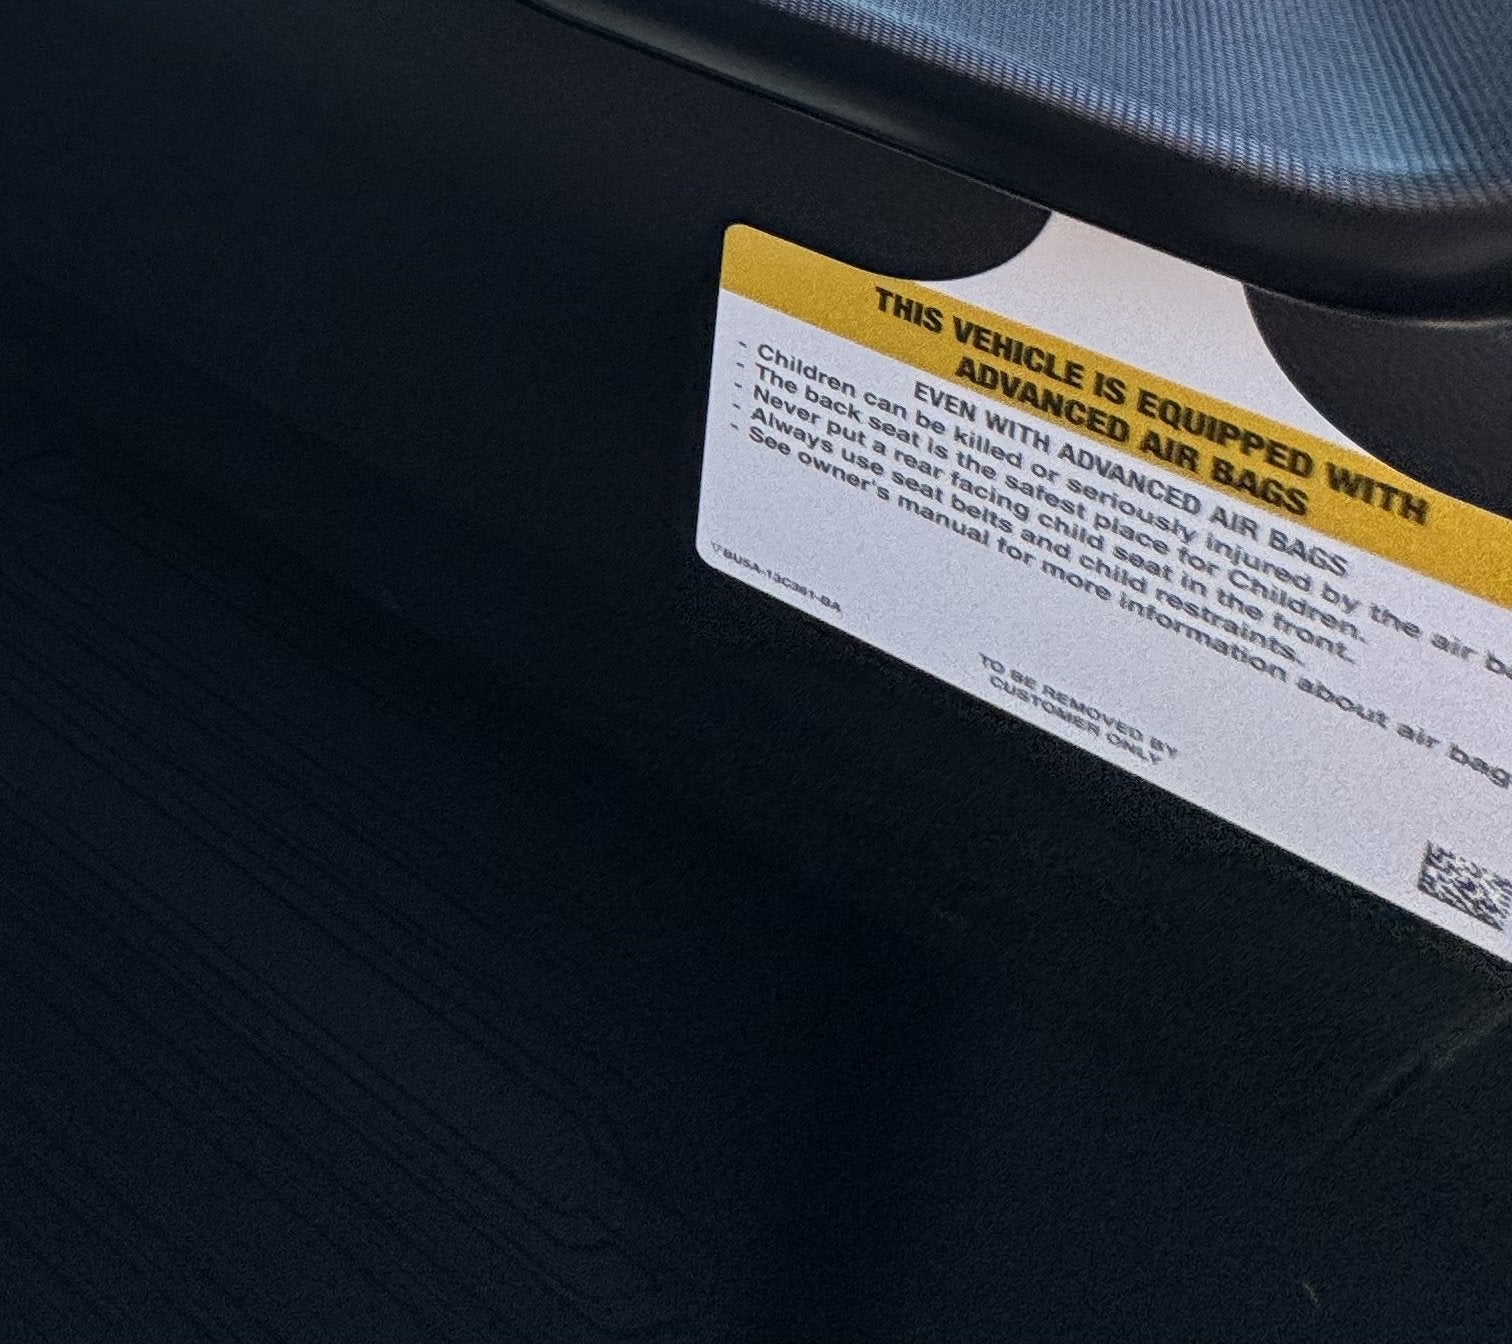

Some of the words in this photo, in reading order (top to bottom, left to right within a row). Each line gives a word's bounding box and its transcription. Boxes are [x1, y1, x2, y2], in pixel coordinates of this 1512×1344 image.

[753, 383, 821, 426] Never
[826, 419, 867, 448] put
[871, 439, 887, 457] a
[893, 448, 945, 480] rear
[949, 470, 1031, 523] facing
[1037, 513, 1105, 552] child
[1112, 545, 1174, 583] seat
[1180, 570, 1208, 598] in
[1216, 588, 1265, 622] the
[1272, 611, 1355, 665] front.
[754, 361, 799, 395] The
[804, 384, 861, 424] back
[867, 415, 920, 449] seat
[926, 436, 949, 460] is
[955, 450, 997, 481] the
[1004, 474, 1087, 521] safest
[1092, 512, 1171, 556] place
[1177, 546, 1221, 577] for
[1227, 568, 1366, 644] Children.
[757, 343, 856, 399] Children
[862, 391, 908, 421] can
[914, 409, 947, 436] be
[953, 425, 1023, 470] killed
[1030, 462, 1060, 484] or
[1066, 478, 1197, 545] seriously
[1205, 532, 1313, 593] injured
[1320, 582, 1361, 615] by
[1370, 604, 1422, 640] the
[1430, 633, 1477, 661] air
[875, 285, 944, 335] THIS
[952, 315, 1085, 391] VEHICLE
[1093, 371, 1127, 406] IS
[1136, 388, 1314, 479] EQUIPPED
[1326, 461, 1428, 526] WITH
[913, 380, 977, 423] EVEN
[985, 409, 1051, 454] WITH
[1057, 442, 1202, 516] ADVANCED
[1208, 505, 1259, 542] AIR
[1268, 527, 1348, 578] BAGS
[954, 356, 1130, 444] ADVANCED
[1139, 429, 1199, 474] AIR
[1210, 456, 1309, 517] BAGS
[748, 425, 792, 456] See
[797, 450, 891, 502] owner's
[897, 494, 990, 547] manual
[996, 536, 1035, 566] for
[1041, 559, 1112, 602] more
[1118, 591, 1288, 683] information
[1295, 676, 1388, 730] about
[1396, 723, 1441, 749] air
[750, 406, 834, 455] Always
[841, 447, 885, 477] use
[891, 470, 944, 504] seat
[950, 493, 1014, 534] belts
[1019, 528, 1072, 561] and
[1078, 554, 1148, 595] child
[1155, 587, 1304, 667] restraints.
[978, 652, 1006, 675] TO
[1009, 668, 1037, 691] BE
[1041, 684, 1144, 743] REMOVED
[1149, 736, 1179, 758] BY
[989, 674, 1101, 738] CUSTOMER
[1105, 732, 1163, 765] ONLY
